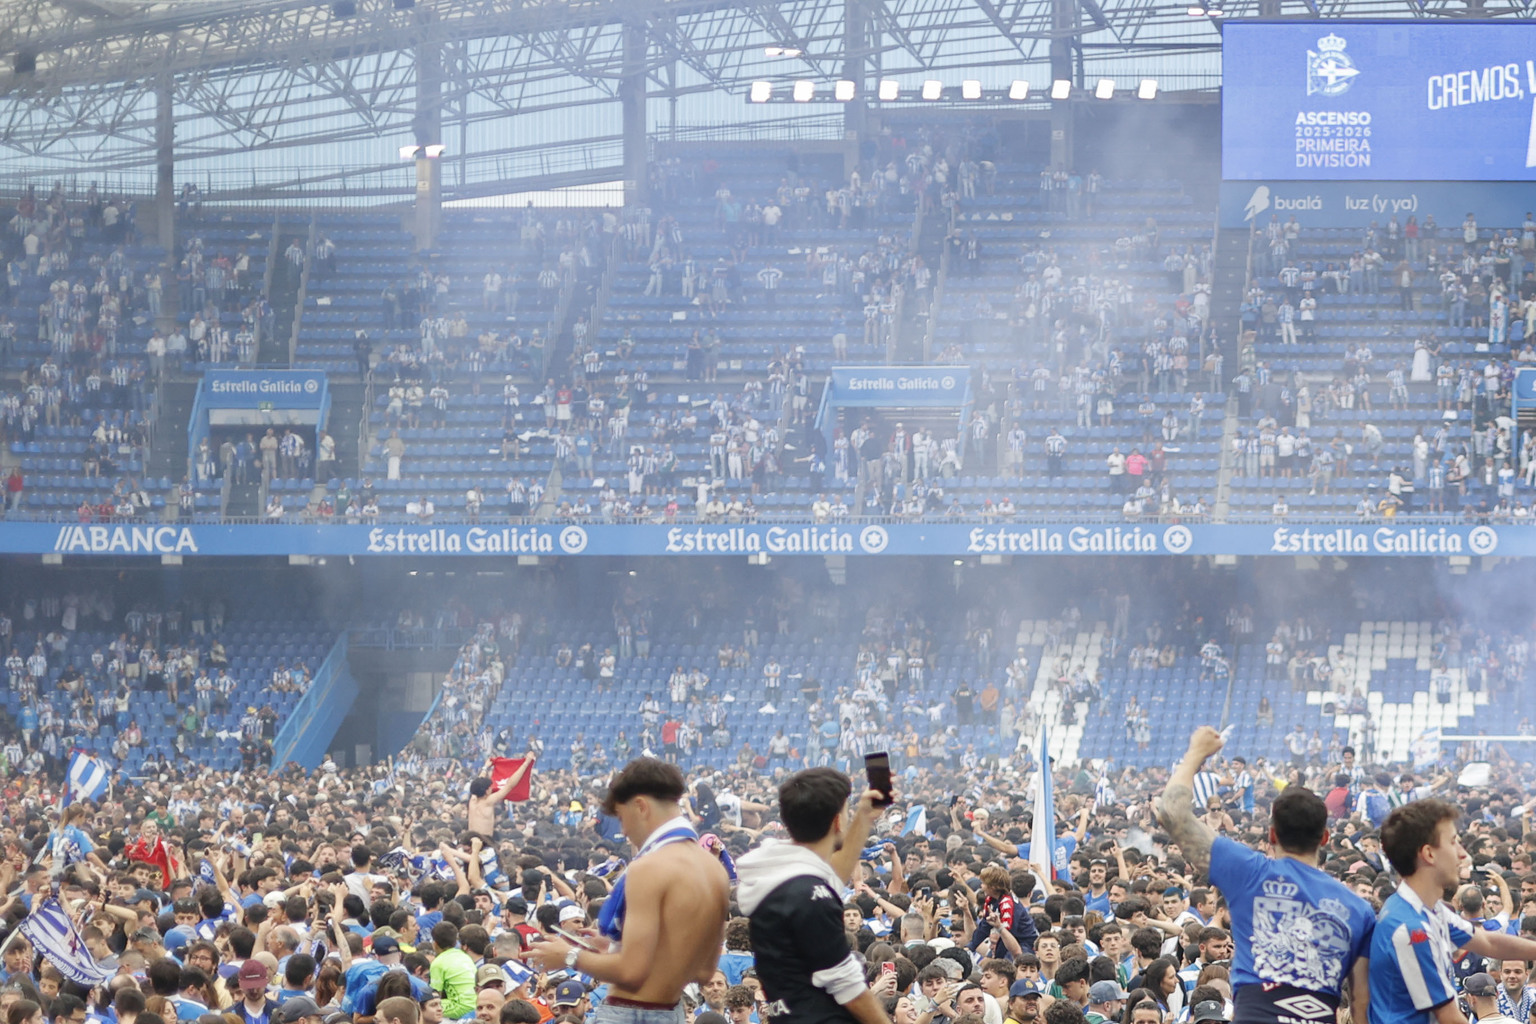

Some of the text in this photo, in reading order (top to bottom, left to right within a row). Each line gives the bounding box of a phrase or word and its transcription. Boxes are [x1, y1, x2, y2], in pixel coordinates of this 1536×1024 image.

[1428, 64, 1524, 111] CREMOS,
[1296, 111, 1371, 126] ASCENSO
[1296, 126, 1371, 137] 2025-2026
[1296, 138, 1371, 152] PRIMEIRA
[1296, 150, 1371, 168] DIVISIÓN
[1275, 195, 1321, 211] bualá
[1346, 195, 1368, 210] luz
[213, 379, 301, 393] Estrella Galicia
[849, 376, 938, 390] Estrella Galicia
[367, 527, 552, 553] Estrella Galicia
[666, 527, 853, 553] Estrella Galicia
[968, 527, 1156, 553] Estrella Galicia
[1271, 527, 1460, 554] Estrella Galicia
